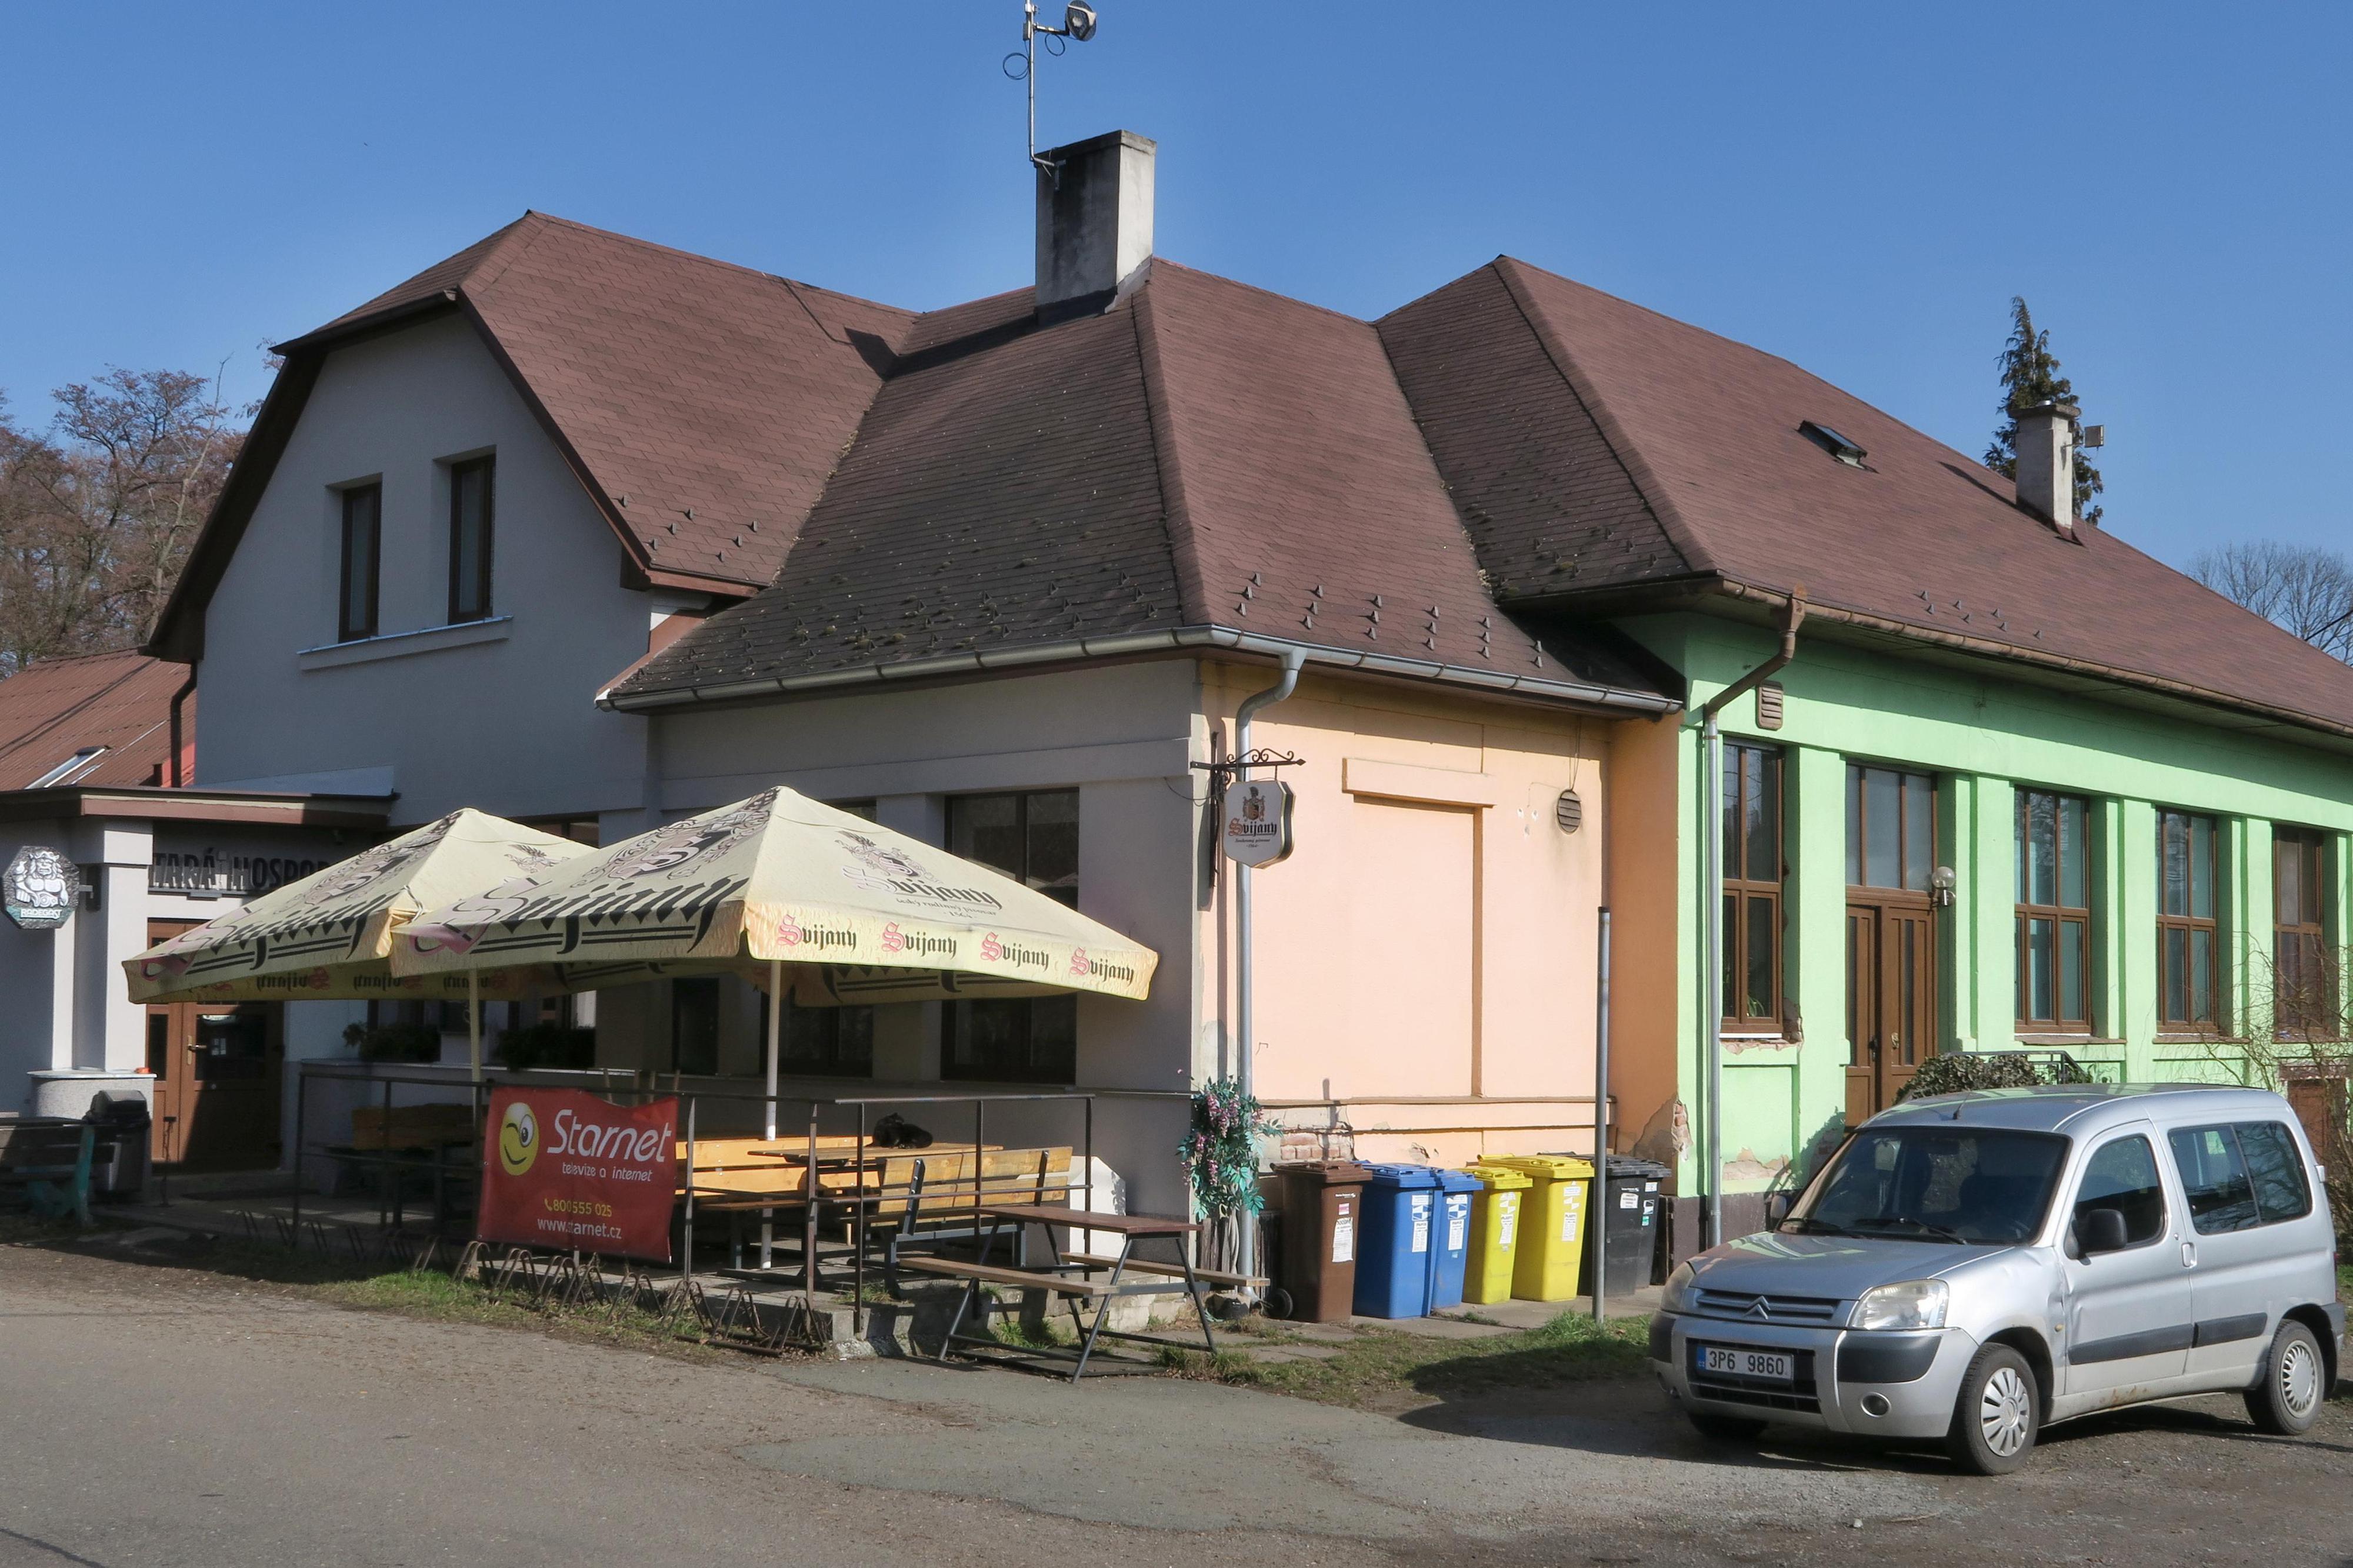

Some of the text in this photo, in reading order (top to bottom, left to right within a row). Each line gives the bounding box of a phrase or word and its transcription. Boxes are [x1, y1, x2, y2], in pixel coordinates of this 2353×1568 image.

[1228, 818, 1277, 836] Svijany
[152, 848, 216, 890] TARÁ
[842, 865, 1002, 910] Svijany
[20, 908, 62, 919] RADEGAST
[409, 874, 750, 955] Svijany
[777, 914, 857, 953] Svijany
[881, 921, 958, 960] Svijany
[980, 932, 1049, 971] Svijany
[1069, 946, 1134, 987] Svijany
[547, 1109, 672, 1163] Starnet
[562, 1162, 652, 1182] televize a internet
[1709, 1351, 1784, 1375] 3P6 9860
